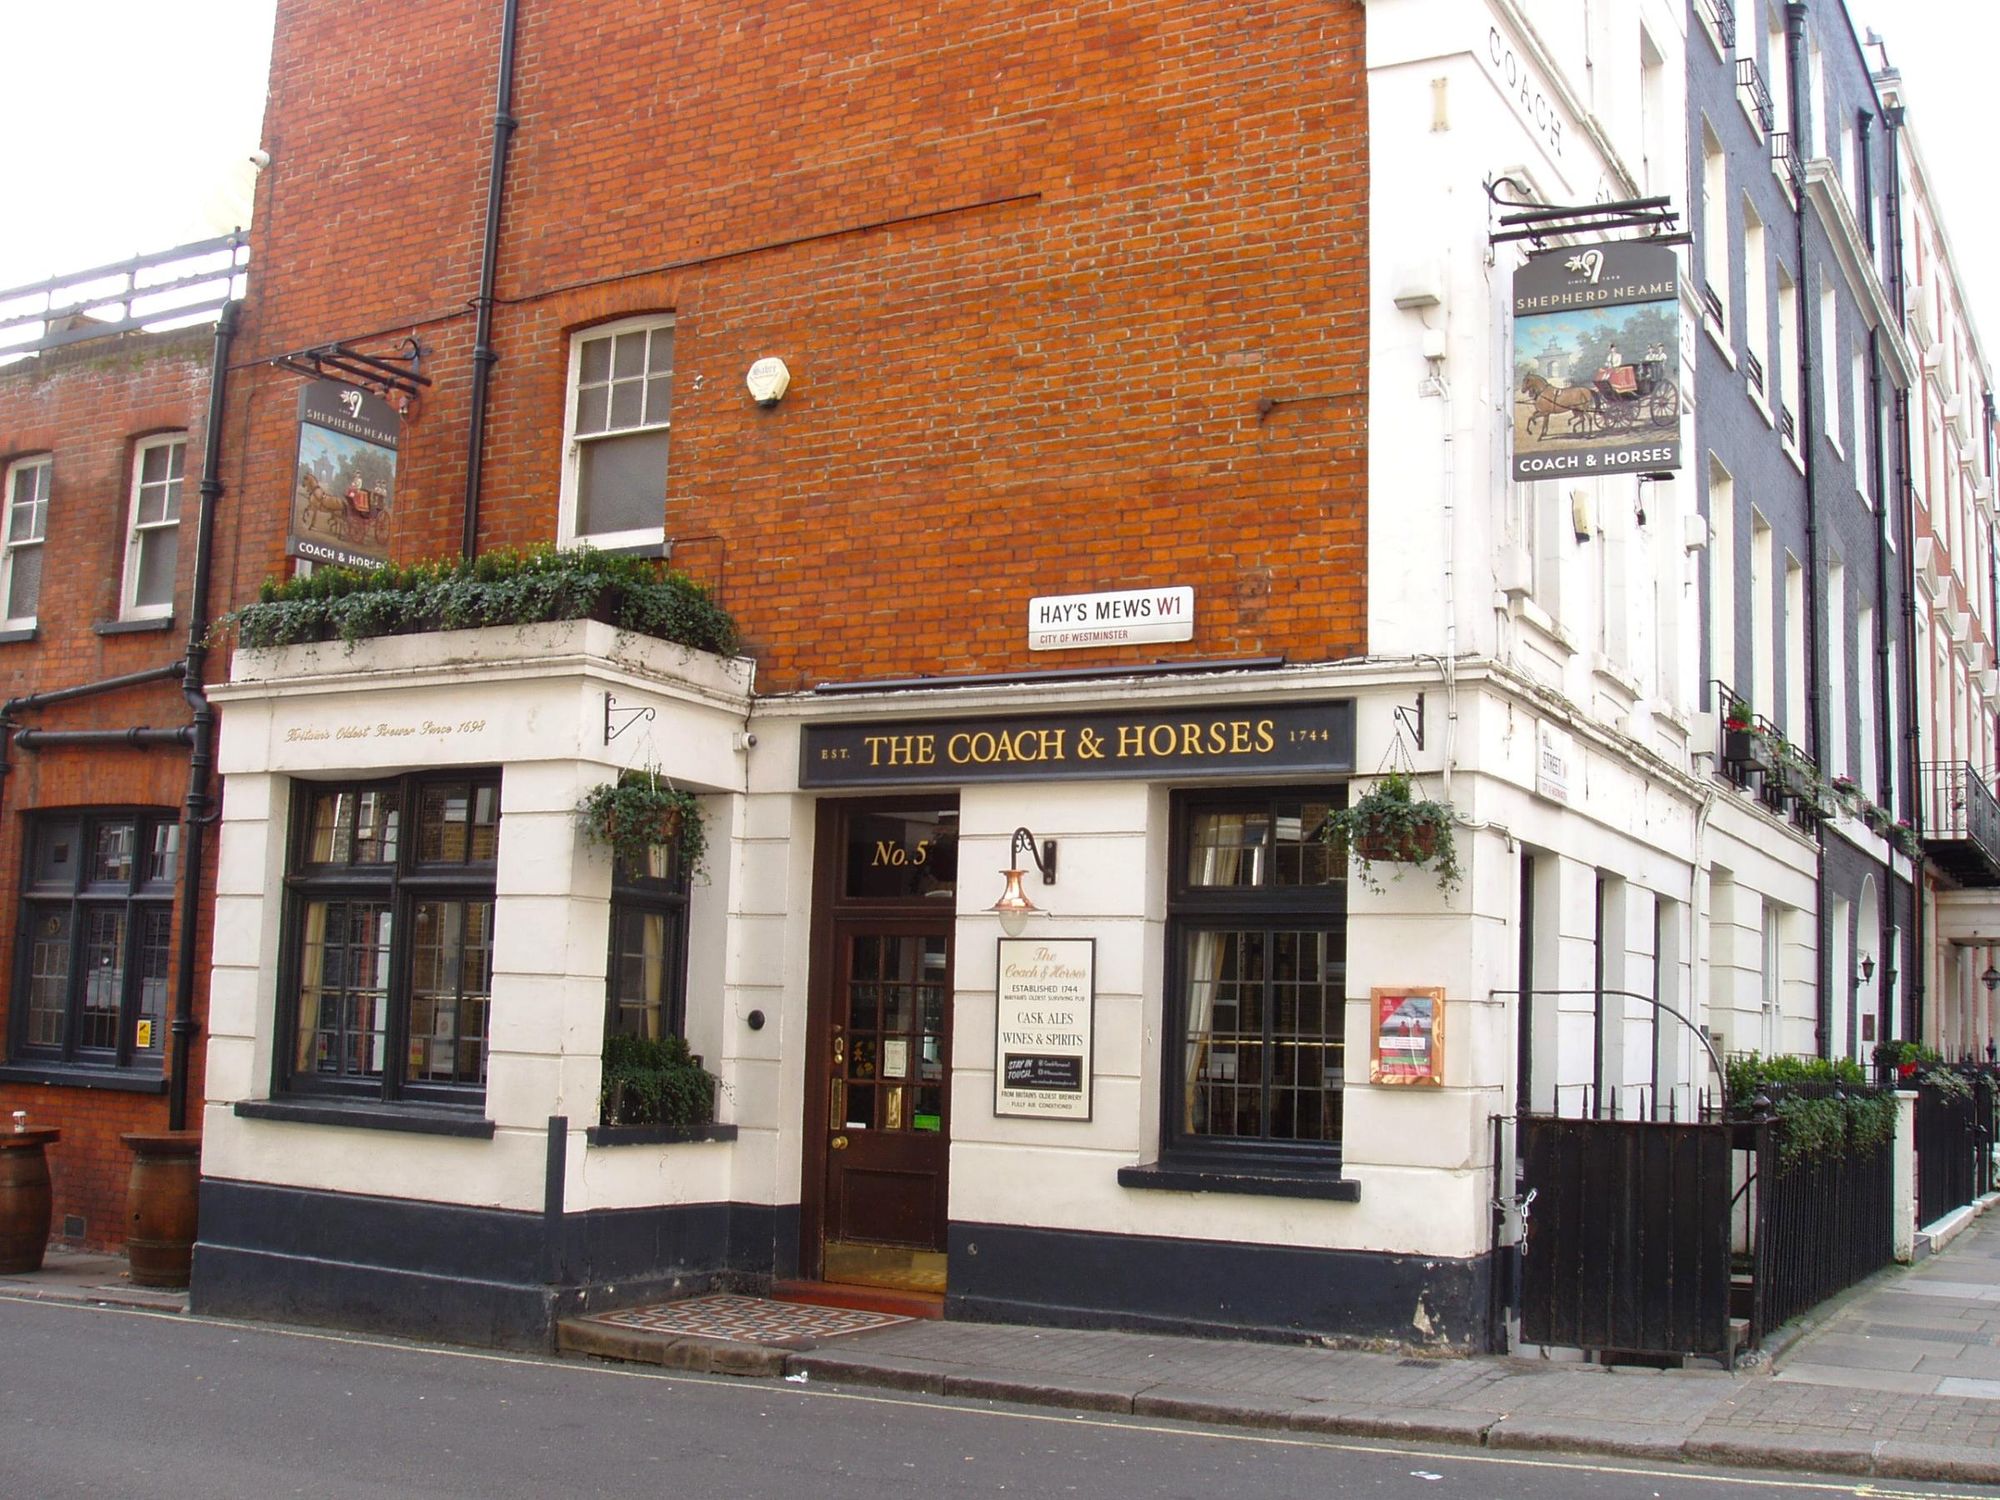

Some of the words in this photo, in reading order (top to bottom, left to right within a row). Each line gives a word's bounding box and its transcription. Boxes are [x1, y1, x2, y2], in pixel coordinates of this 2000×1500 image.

[1490, 26, 1561, 157] COACH
[1517, 289, 1608, 310] SHEPHERD
[1613, 281, 1674, 298] NEAME
[306, 408, 362, 433] SHEPHERD
[364, 427, 397, 445] NEAME
[1519, 456, 1578, 472] COACH
[1585, 454, 1597, 467] &
[1604, 448, 1672, 465] HORSES
[299, 542, 335, 559] COACH
[338, 552, 346, 562] &
[1040, 603, 1087, 624] HAY'S
[1096, 598, 1151, 620] MEWS
[1157, 596, 1180, 616] W1
[1040, 635, 1057, 644] CITY
[1060, 633, 1070, 643] OF
[1071, 630, 1128, 642] WESTMINSTER
[336, 726, 372, 740] Oldest
[374, 723, 416, 738] Brewer
[419, 720, 453, 736] Since
[456, 719, 487, 734] 1698
[821, 749, 850, 759] EST.
[864, 735, 936, 766] THE
[948, 730, 1066, 764] COACH
[1077, 727, 1105, 759] &
[1116, 719, 1275, 757] HORSES
[1289, 729, 1329, 742] 1744
[871, 840, 908, 866] No.
[913, 840, 929, 865] 5
[1033, 947, 1056, 961] The
[1005, 964, 1038, 978] Coach
[1050, 965, 1086, 979] Horses
[1012, 985, 1058, 993] ESTABLISHED
[1061, 985, 1078, 993] 1744
[1017, 1012, 1044, 1025] CASK
[1047, 1012, 1074, 1025] ALES
[1003, 1031, 1034, 1045] WINES
[1036, 1034, 1043, 1045] &
[1046, 1033, 1083, 1046] SPIRITS
[1008, 1060, 1025, 1070] STAY
